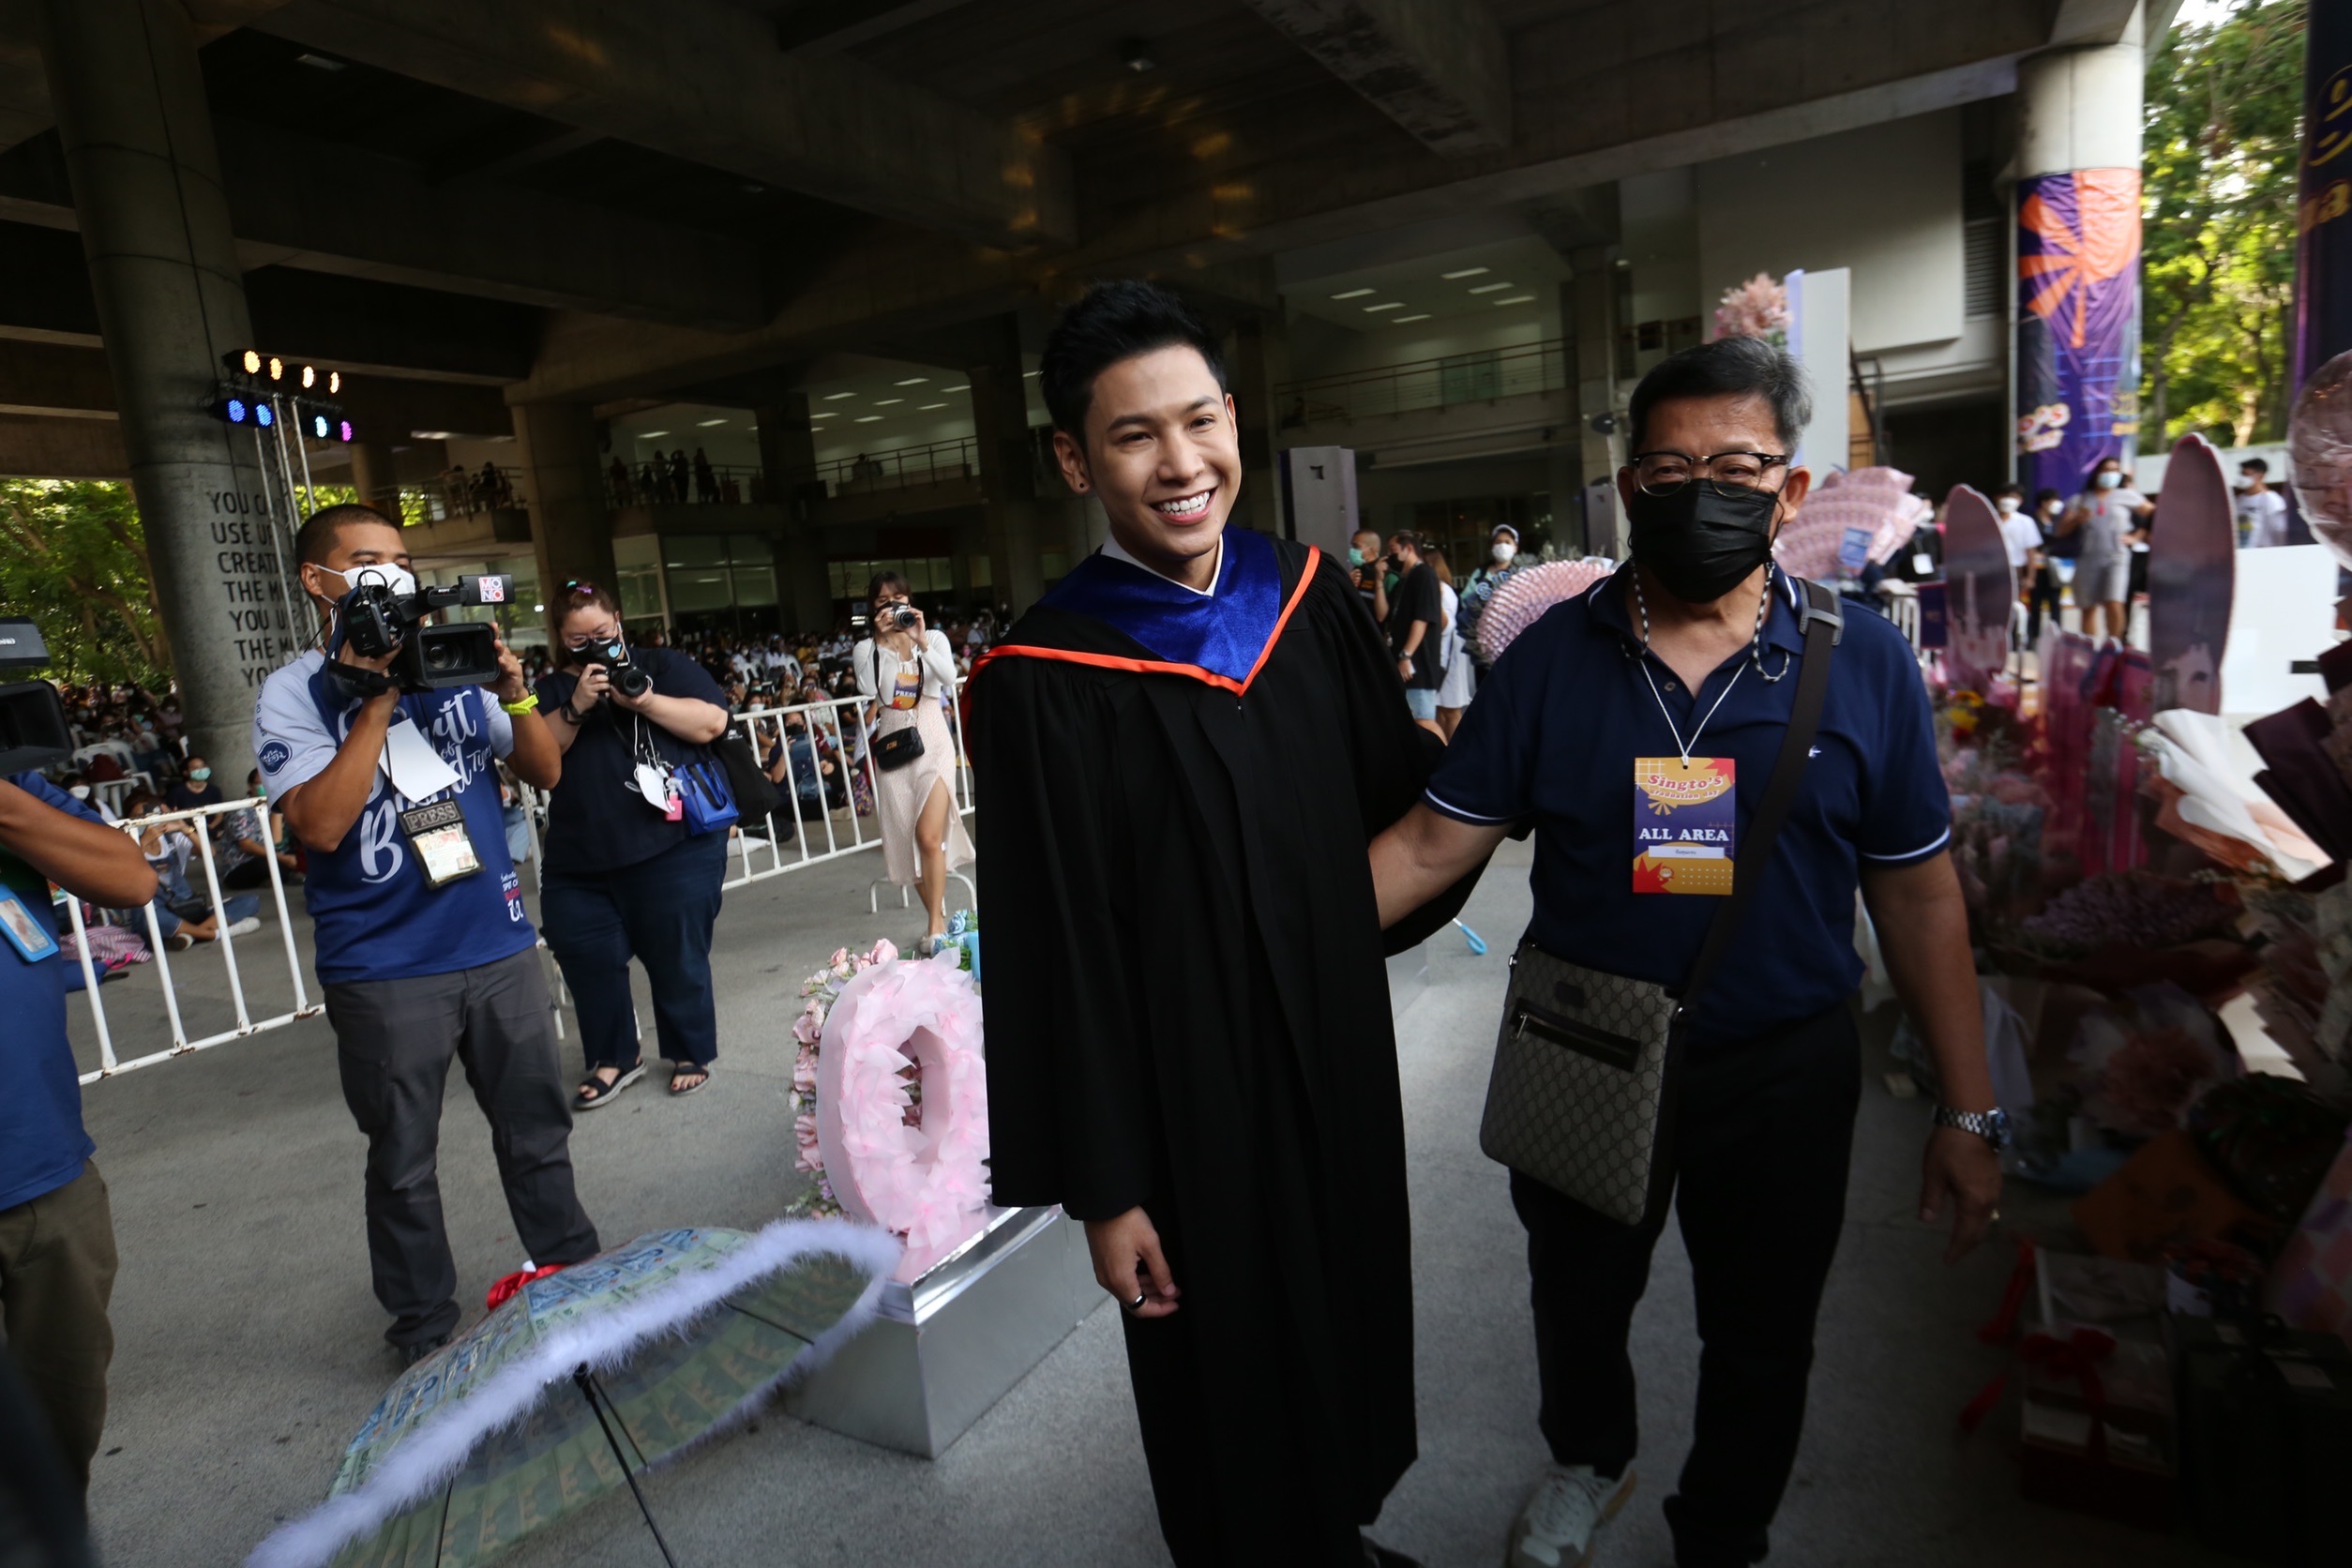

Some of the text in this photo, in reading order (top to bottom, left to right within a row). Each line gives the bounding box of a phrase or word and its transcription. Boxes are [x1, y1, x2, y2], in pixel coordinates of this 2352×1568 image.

[208, 491, 249, 514] YOU
[211, 522, 253, 545] USE
[223, 580, 264, 603] THE
[230, 610, 270, 632] YOU
[234, 638, 276, 661] THE
[896, 690, 917, 699] PRESS
[1648, 775, 1724, 792] Singto's
[1650, 789, 1700, 800] graduation
[409, 805, 458, 828] PRESS
[1638, 828, 1729, 842] ALL AREA
